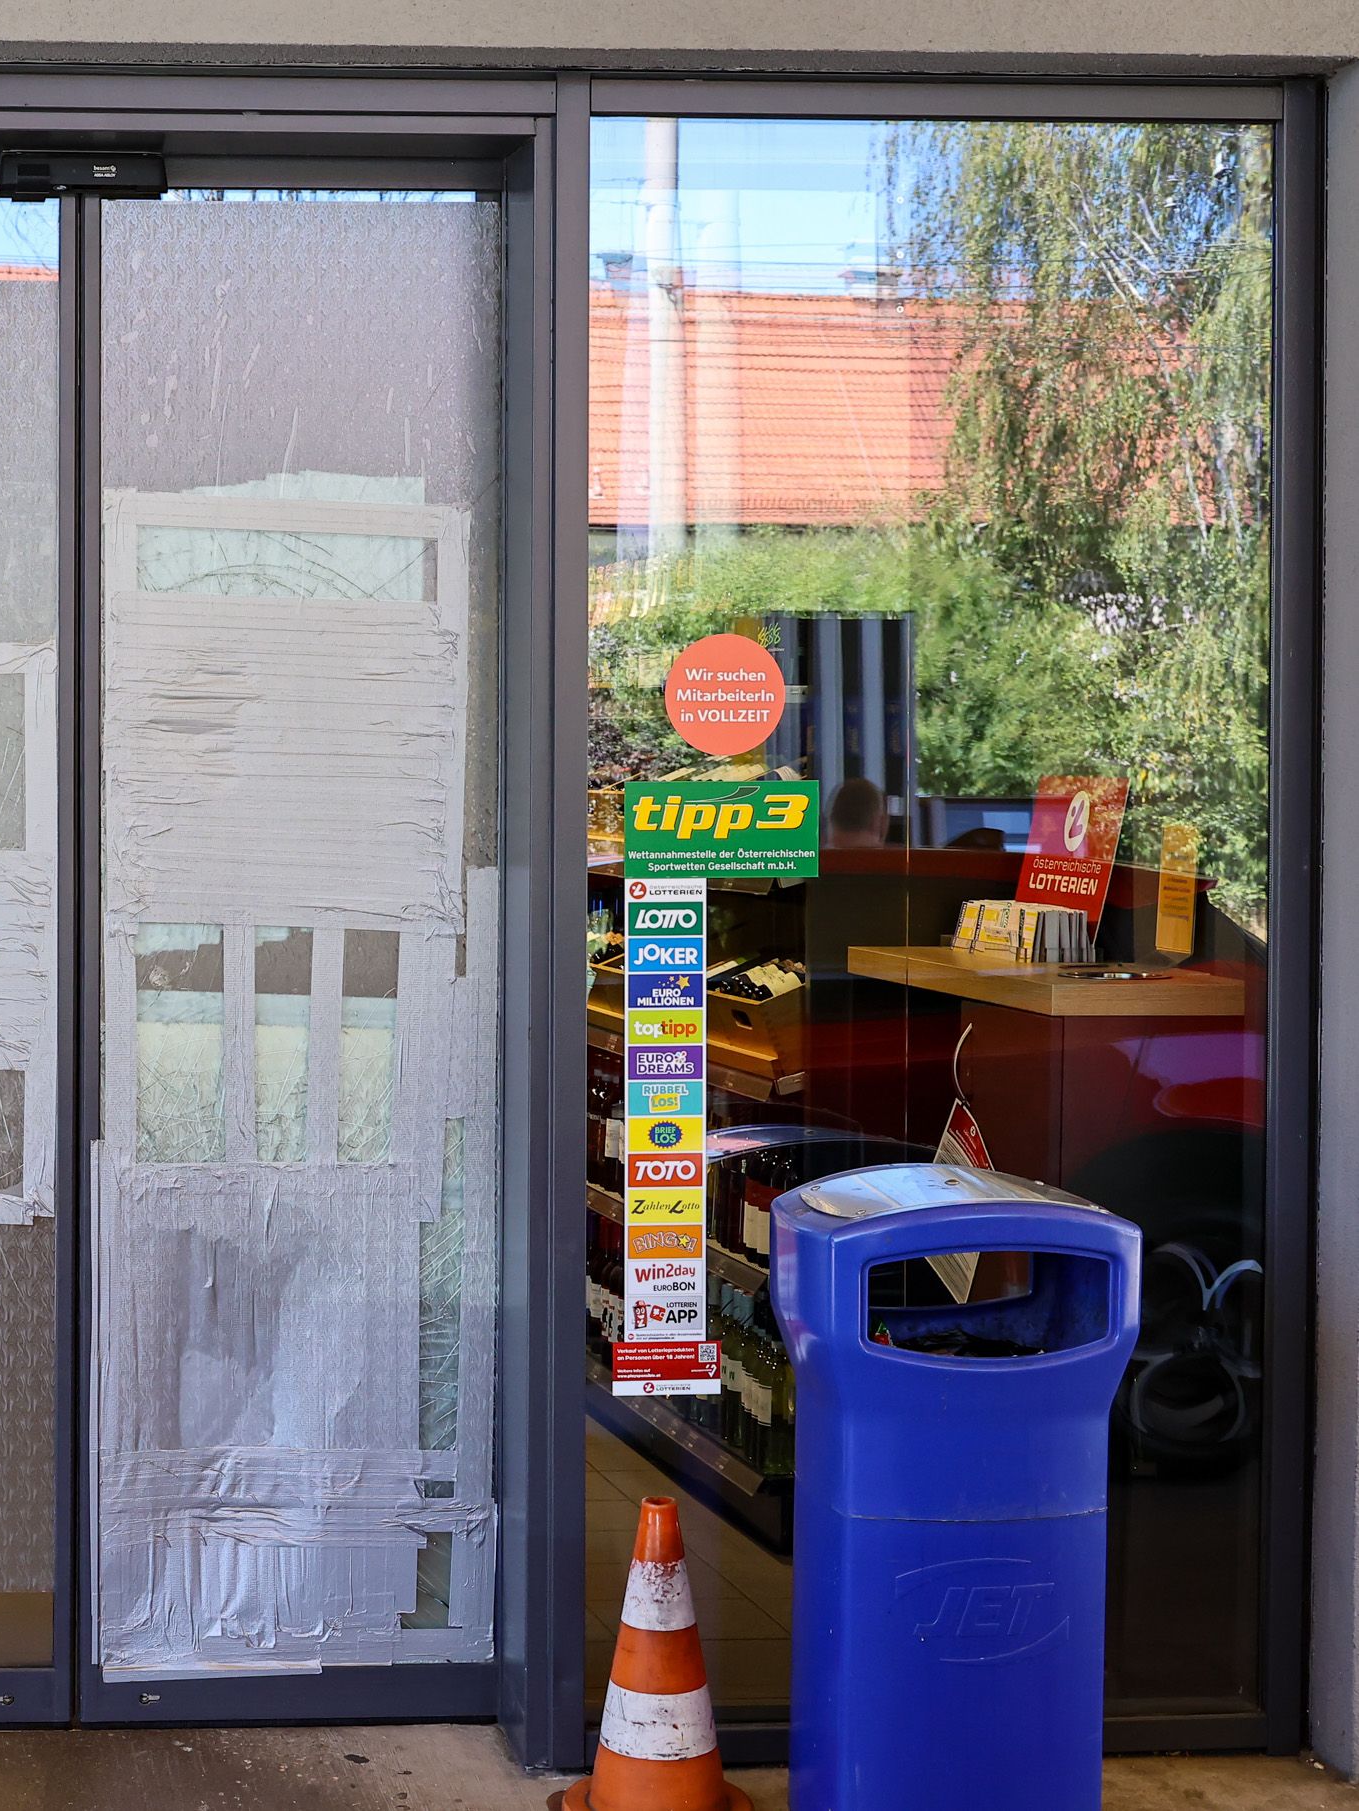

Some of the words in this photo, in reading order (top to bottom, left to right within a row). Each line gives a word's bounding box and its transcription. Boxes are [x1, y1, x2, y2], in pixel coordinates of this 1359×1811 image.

[685, 668, 713, 681] Wir
[716, 667, 766, 681] suchen
[676, 688, 775, 702] MitarbeiterIn
[680, 708, 694, 722] in
[697, 708, 770, 723] VOLLZEIT
[628, 849, 717, 860] Wettannahmestelle
[719, 850, 734, 859] der
[737, 848, 816, 859] Österreichischen
[648, 862, 706, 873] Sportwetten
[708, 861, 765, 871] Gesellschaft
[767, 861, 797, 870] m.b.H.
[1033, 855, 1102, 875] österreichische
[1029, 872, 1099, 896] LOTTERIEN
[634, 908, 698, 930] LOTTO
[633, 944, 698, 966] JOKER
[652, 988, 682, 997] EURO
[637, 996, 695, 1006] MILLIONEN
[634, 1019, 698, 1038] toptipp
[638, 1053, 673, 1063] EURO
[638, 1063, 693, 1073] DREAMS
[643, 1085, 688, 1095] RUBBEL
[654, 1126, 676, 1134] BRIEF
[654, 1134, 677, 1144] LOS
[635, 1159, 697, 1181] TOTO
[635, 1263, 696, 1284] win2day
[665, 1309, 698, 1324] APP
[913, 1582, 1055, 1637] JET
